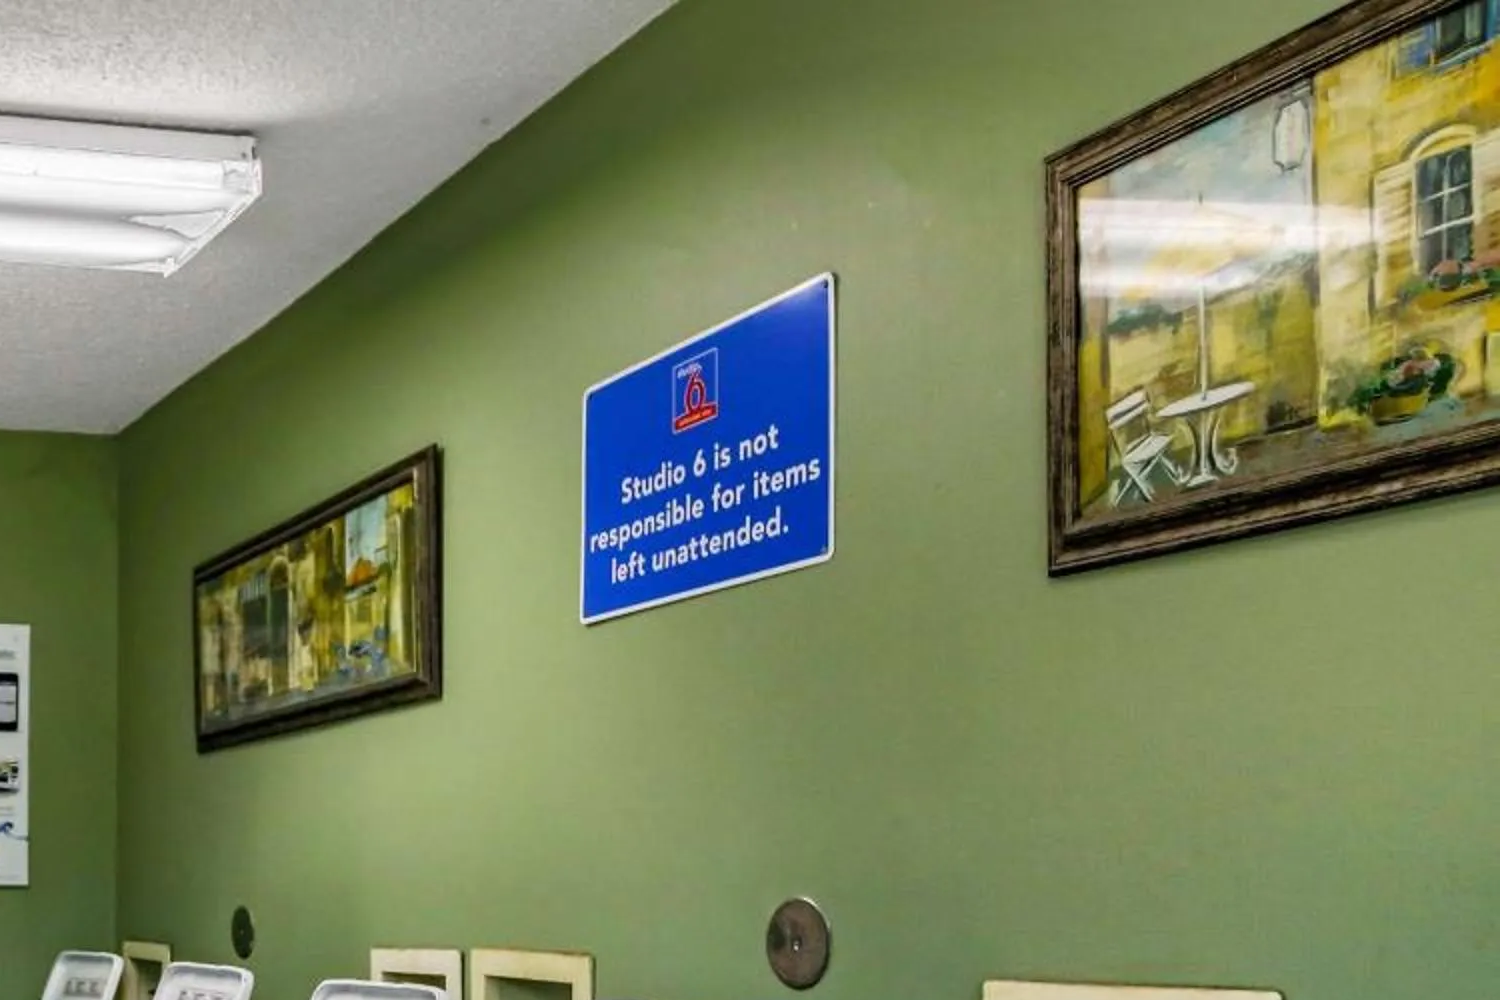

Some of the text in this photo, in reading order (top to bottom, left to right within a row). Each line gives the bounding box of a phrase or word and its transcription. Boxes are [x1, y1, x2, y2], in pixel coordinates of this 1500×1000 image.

[621, 424, 779, 504] Studio 6 is not
[589, 458, 821, 553] responsible for items
[611, 505, 790, 584] left unattended.
